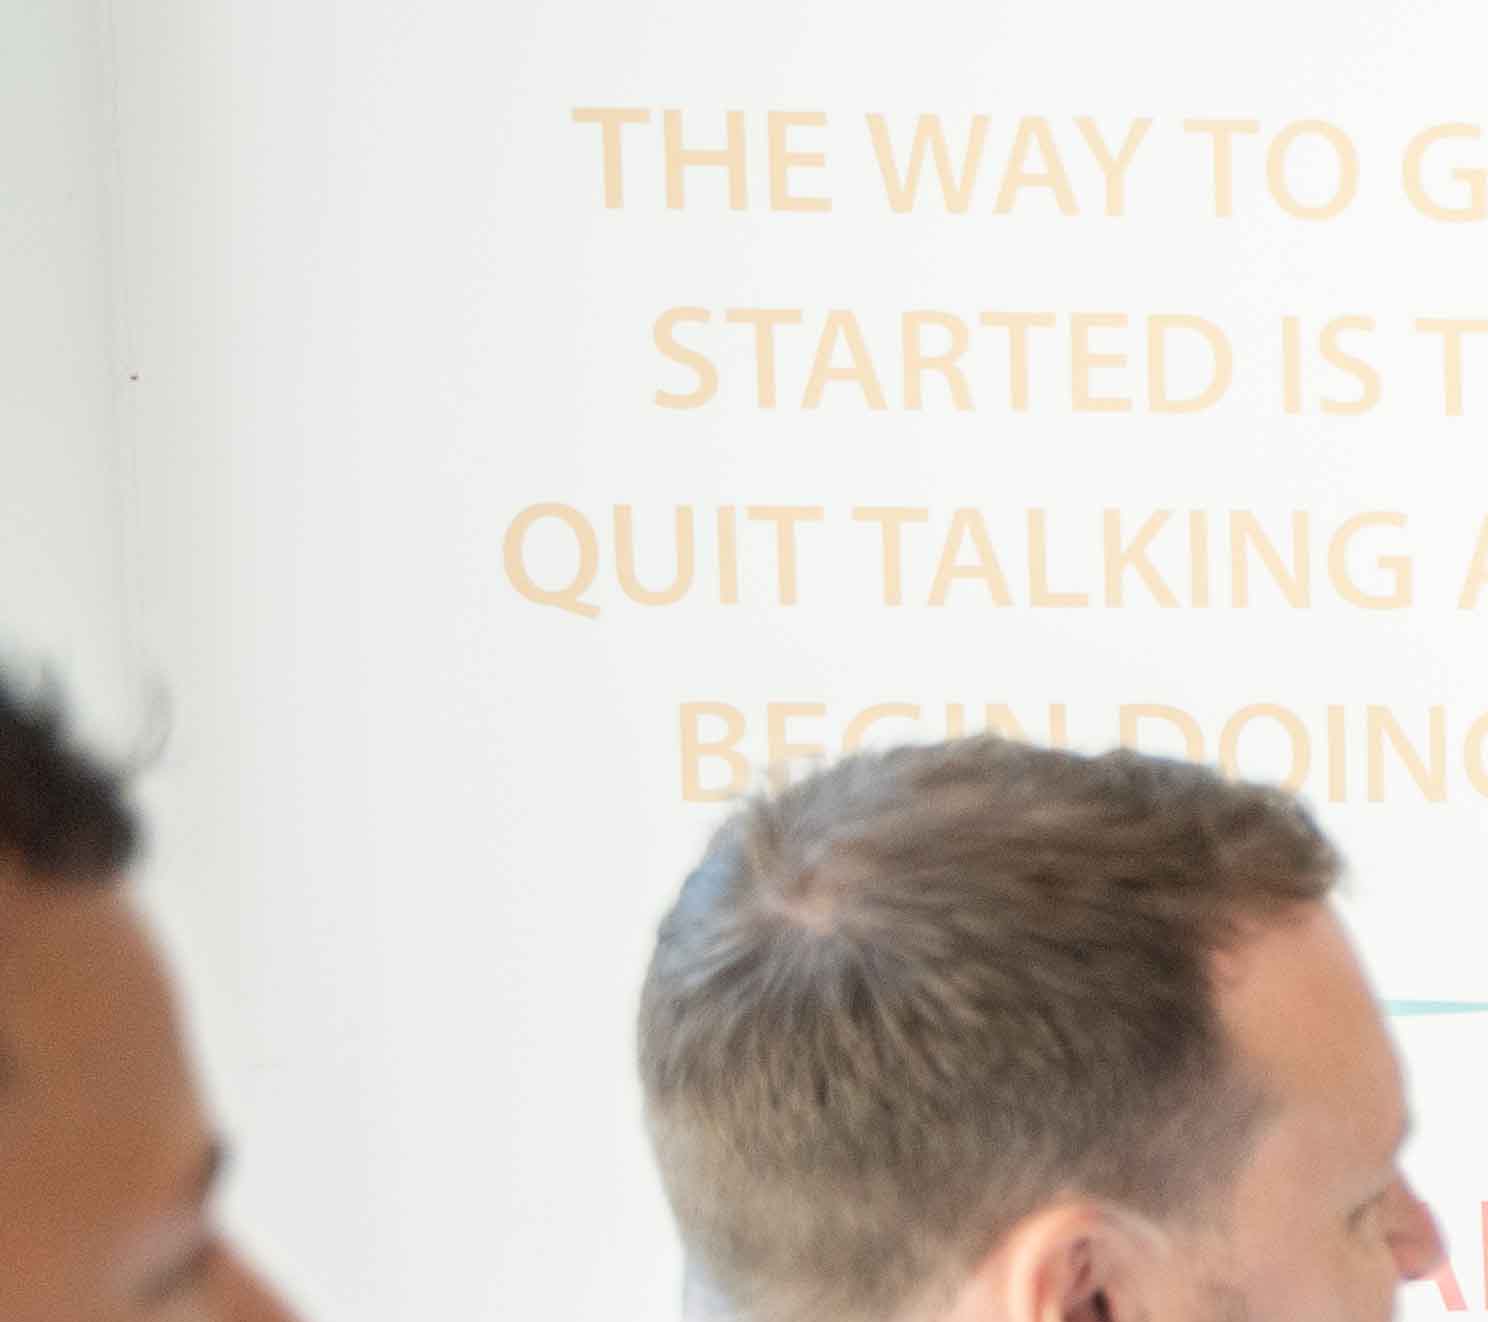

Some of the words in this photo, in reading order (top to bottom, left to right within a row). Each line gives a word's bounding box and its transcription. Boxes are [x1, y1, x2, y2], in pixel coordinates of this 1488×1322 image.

[567, 105, 834, 215] THE
[863, 110, 1154, 219] WAY
[1182, 116, 1361, 223] TO
[650, 304, 1236, 417] STARTED
[1278, 313, 1384, 418] IS
[500, 499, 826, 620] QUIT
[849, 501, 1415, 612] TALKING
